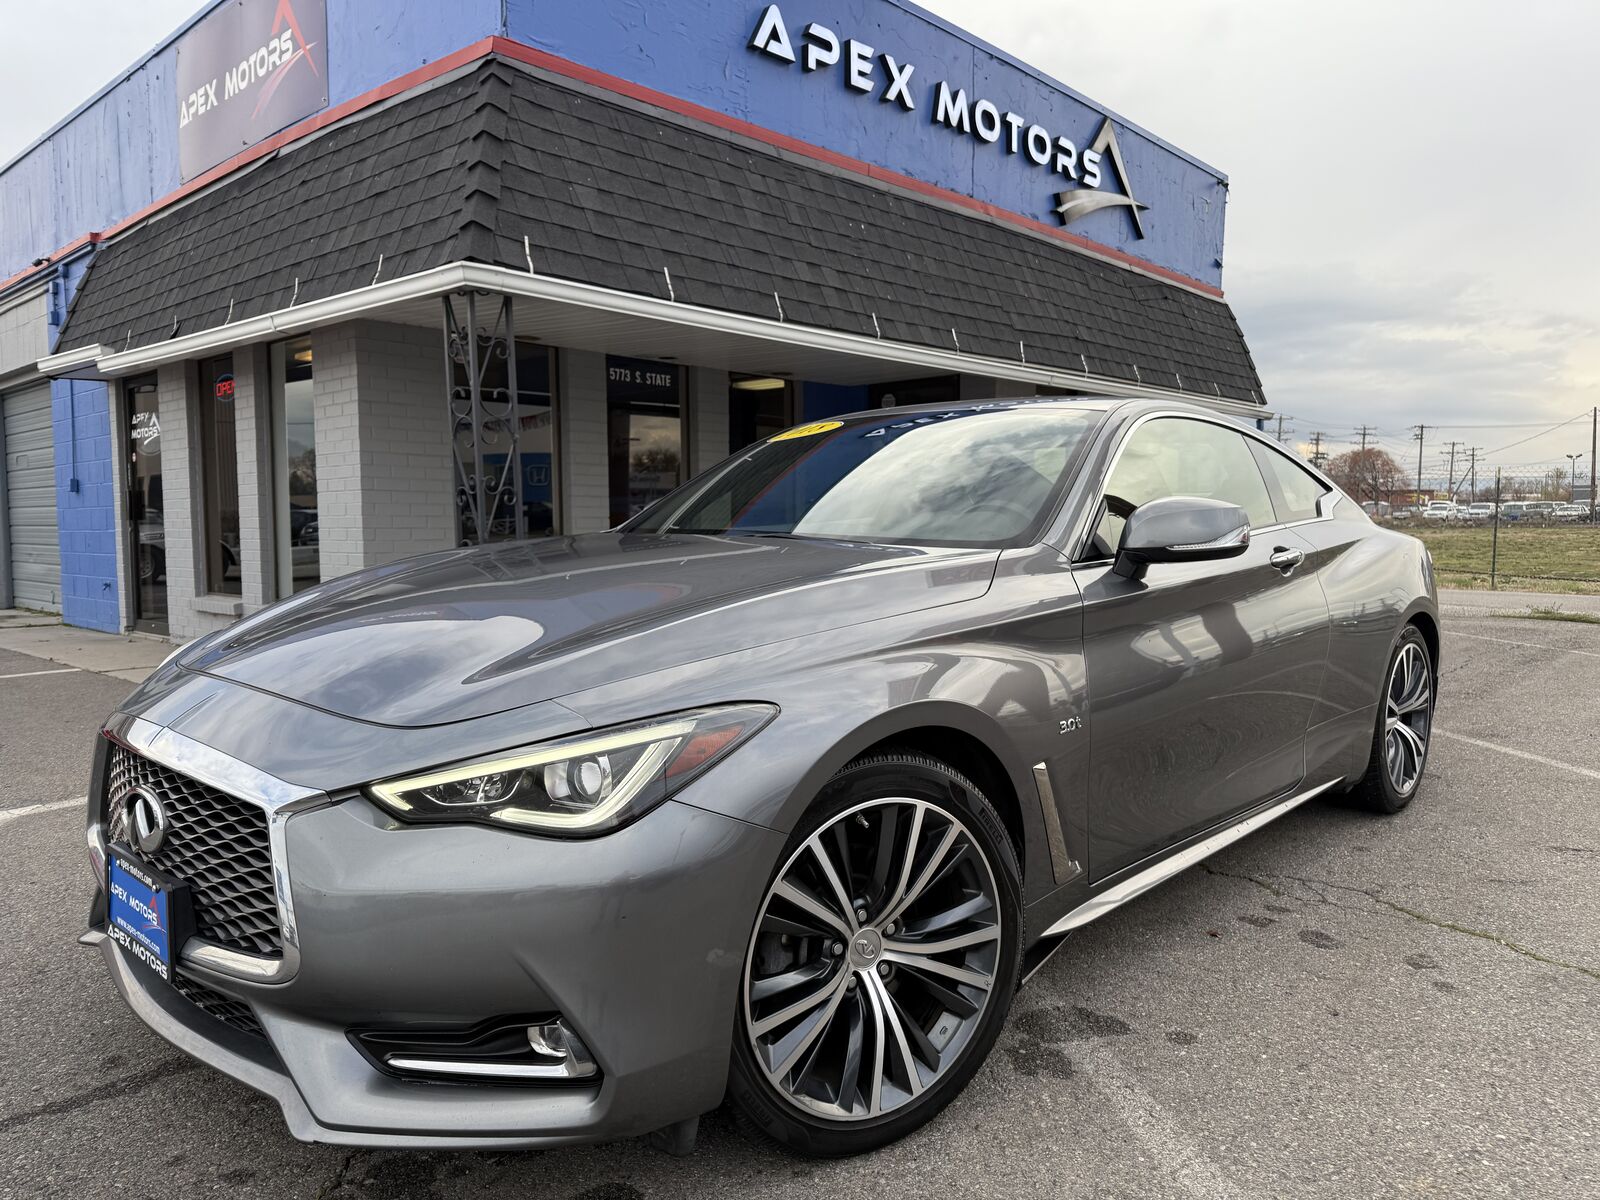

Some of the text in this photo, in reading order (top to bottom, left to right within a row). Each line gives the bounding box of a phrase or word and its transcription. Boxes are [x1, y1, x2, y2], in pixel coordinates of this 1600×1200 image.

[179, 28, 293, 129] APEX MOTORS
[748, 4, 1102, 189] APEX MOTORS
[609, 367, 672, 387] 5773 S. STATE
[131, 426, 158, 439] MOTORS
[110, 881, 158, 926] APEX MOTORS
[107, 923, 168, 980] APEX MOTORS
